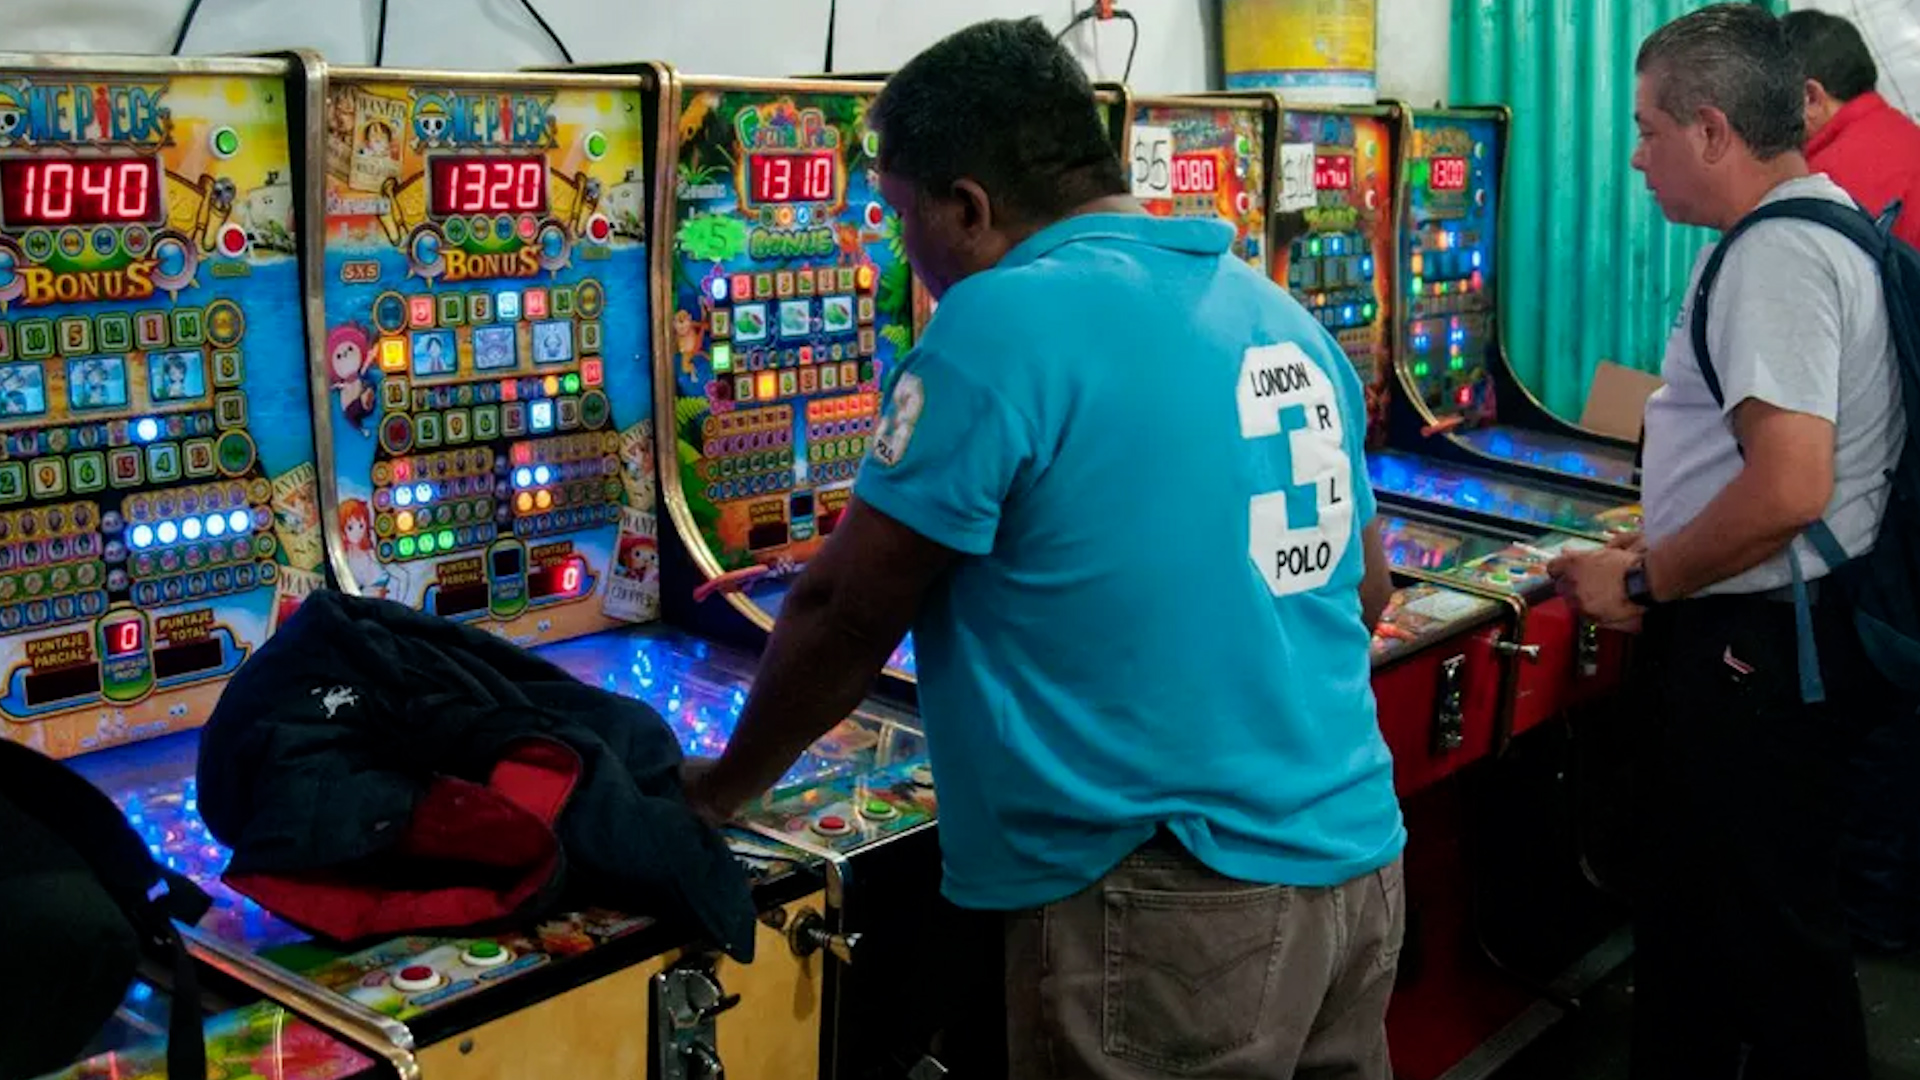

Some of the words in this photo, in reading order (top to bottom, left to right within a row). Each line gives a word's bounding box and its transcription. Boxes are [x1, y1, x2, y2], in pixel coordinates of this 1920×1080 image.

[449, 163, 541, 211] 1320
[763, 157, 831, 199] 1310
[1171, 159, 1215, 191] 1080
[1433, 159, 1464, 187] 1300
[24, 163, 149, 218] 1040
[443, 247, 540, 280] BONUS
[22, 261, 155, 304] BONUS
[1250, 362, 1311, 398] LONDON
[1316, 404, 1332, 430] R
[1330, 477, 1342, 505] L
[1275, 541, 1332, 580] POLO
[562, 566, 578, 591] 0
[158, 611, 213, 631] PUNTAJE
[29, 633, 85, 652] PUNTAJE
[121, 623, 139, 650] 0
[172, 629, 207, 642] TOTAL
[34, 649, 86, 669] PARCIAL
